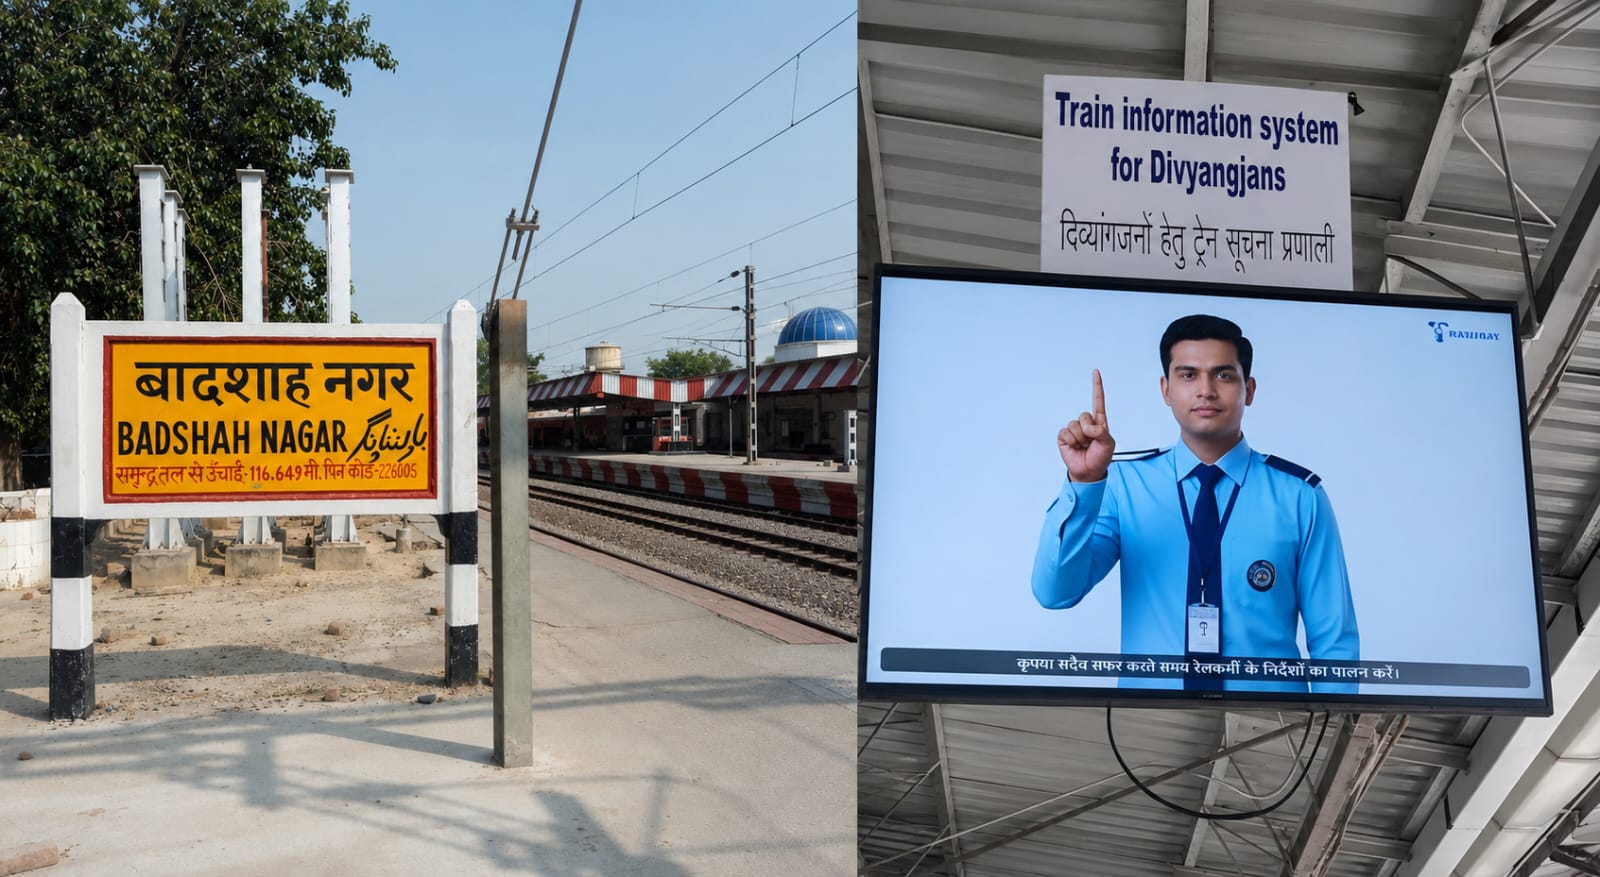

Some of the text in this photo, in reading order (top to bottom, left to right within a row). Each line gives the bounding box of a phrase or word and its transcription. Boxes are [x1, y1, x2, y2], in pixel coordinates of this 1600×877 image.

[1055, 92, 1339, 150] Train information system
[1111, 146, 1286, 197] for Divyangjans
[1060, 208, 1335, 274] दिव्यांगजनों हेतु ट्रेन सूचना प्रणाली
[134, 362, 415, 408] बादशाह नगर
[118, 419, 348, 455] BADSHAH NAGAR
[188, 460, 204, 484] से
[323, 458, 346, 480] पिन
[1016, 658, 1054, 673] कृपया
[1057, 654, 1088, 672] सदैव
[1091, 659, 1123, 672] सफर
[1126, 658, 1157, 673] करते
[1159, 662, 1190, 674] समय
[1244, 660, 1260, 675] के
[1309, 664, 1329, 678] का
[1331, 666, 1369, 679] पालन
